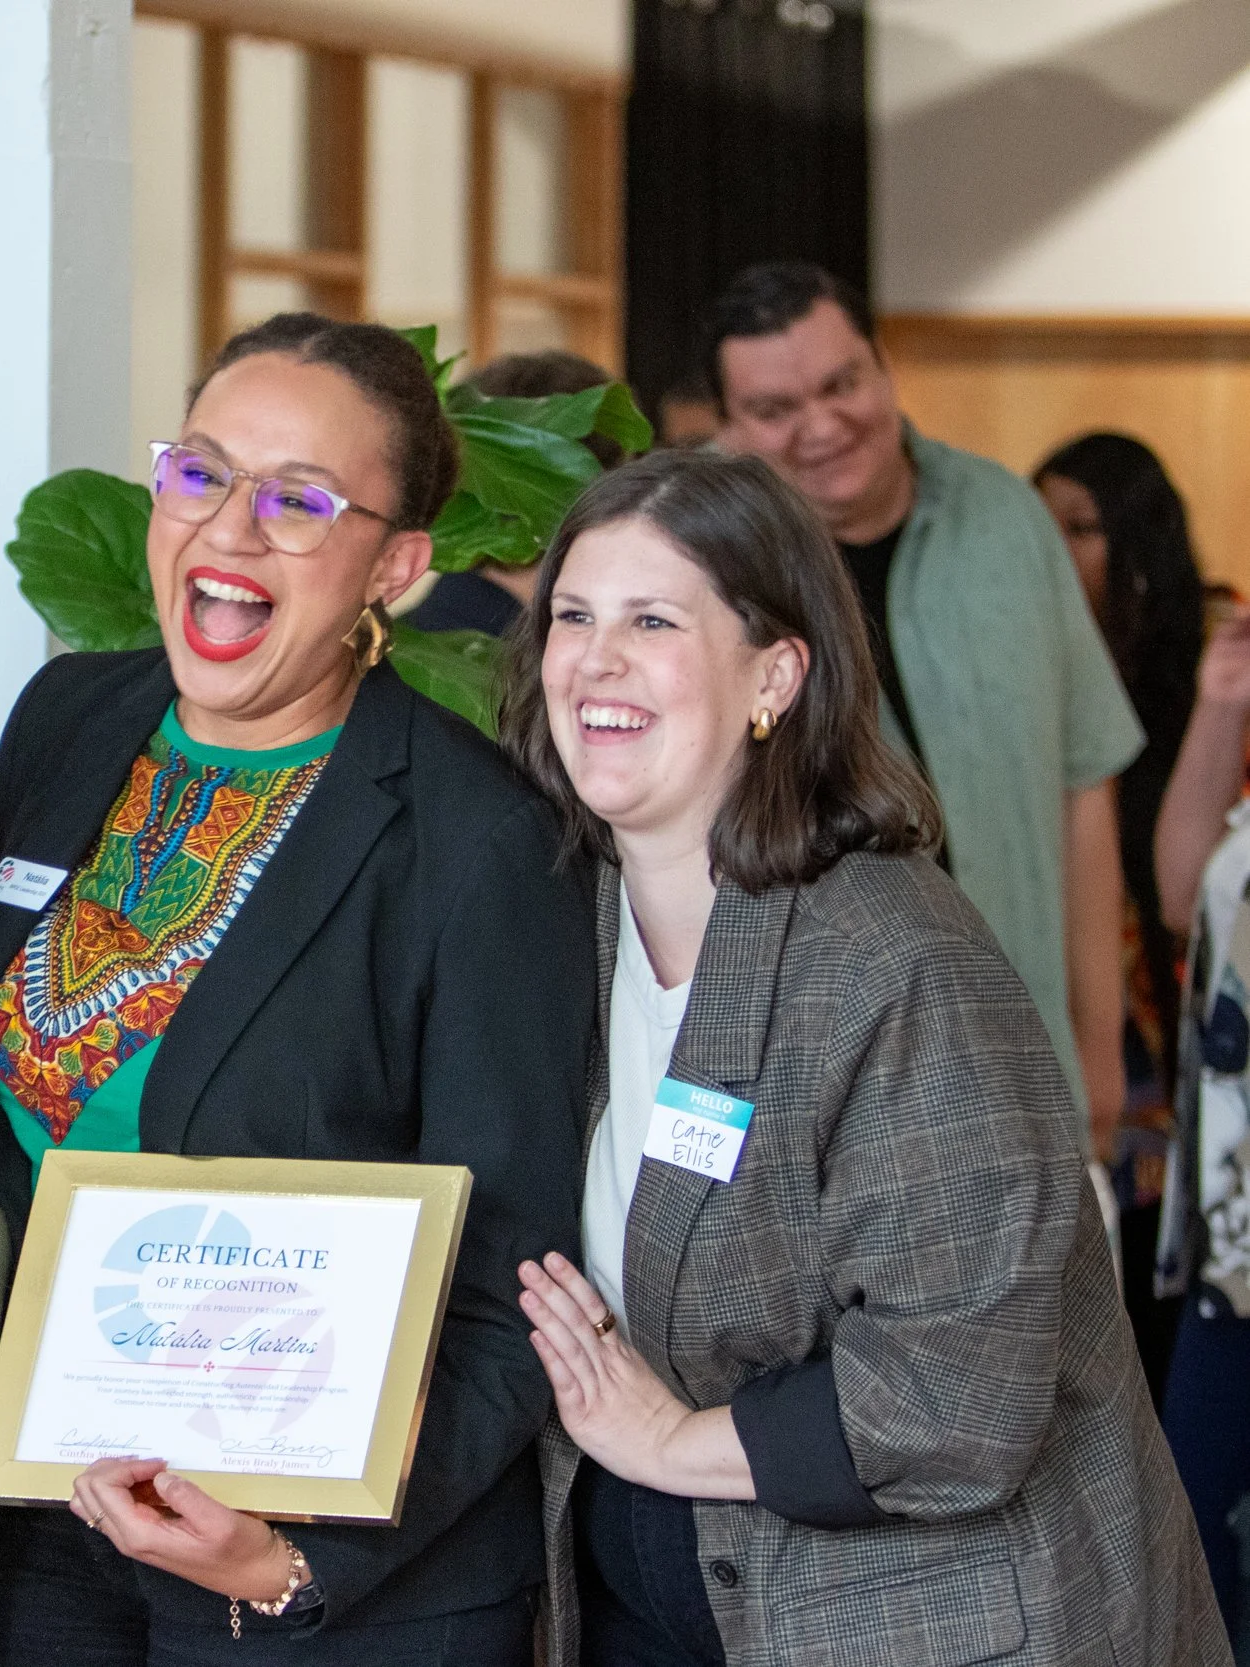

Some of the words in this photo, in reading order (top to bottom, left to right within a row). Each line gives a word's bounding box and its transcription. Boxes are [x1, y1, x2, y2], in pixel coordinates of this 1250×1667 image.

[690, 1090, 734, 1114] HELLO
[671, 1119, 726, 1149] Catie
[673, 1144, 714, 1169] Ellis
[137, 1242, 329, 1270] CERTIFICATE
[157, 1276, 180, 1289] OF
[182, 1278, 299, 1294] RECOGNITION
[126, 1301, 144, 1310] THIS
[146, 1302, 203, 1312] CERTIFICATE
[203, 1304, 211, 1312] IS
[213, 1304, 253, 1314] PROUDLY
[254, 1306, 304, 1316] PRESENTED
[219, 1327, 318, 1356] Martins
[220, 1456, 250, 1466] Alexis
[280, 1459, 310, 1469] James
